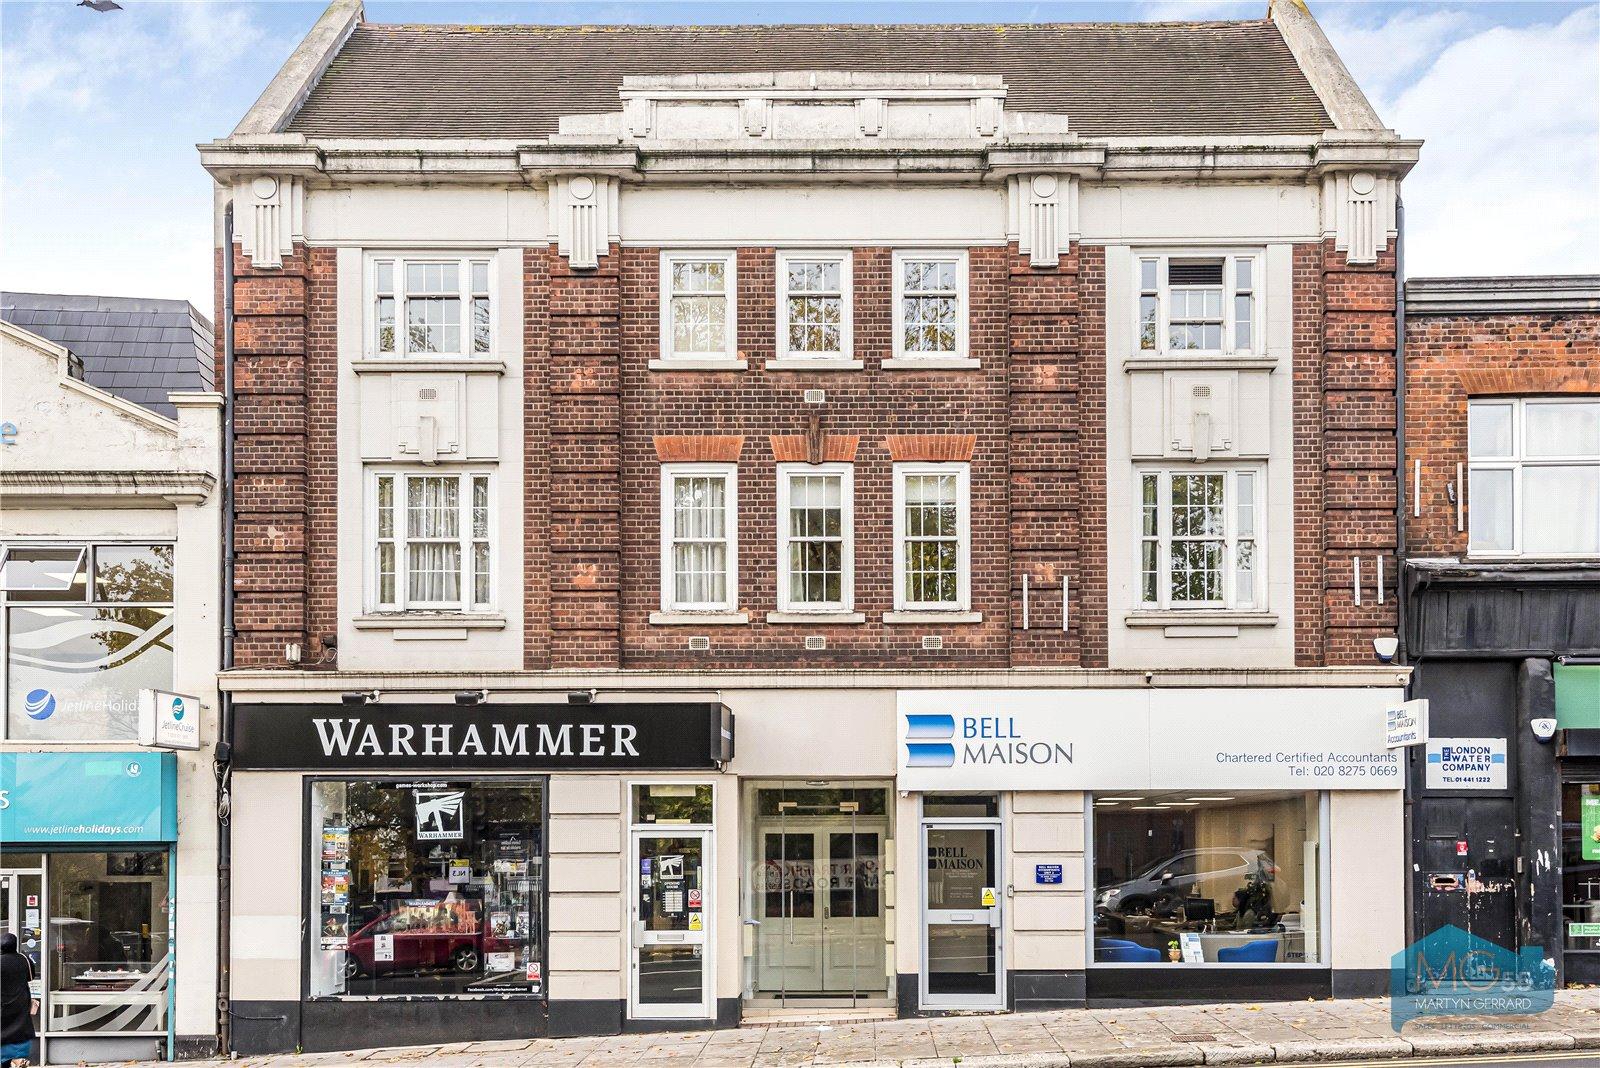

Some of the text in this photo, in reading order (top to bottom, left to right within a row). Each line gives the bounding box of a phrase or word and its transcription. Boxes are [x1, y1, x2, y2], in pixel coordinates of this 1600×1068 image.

[1396, 709, 1407, 719] BELL
[162, 720, 195, 733] JetlineCruise
[963, 717, 1022, 738] BELL
[1397, 718, 1417, 728] MAISON
[313, 719, 640, 757] WARHAMMER
[1387, 732, 1417, 743] Accountants
[963, 742, 1074, 764] MAISON
[1216, 752, 1398, 763] Chartered Certified Accountants
[1288, 765, 1398, 776] Tel: 020 8275 0669
[24, 824, 144, 836] www.jetlineholidays.com
[938, 847, 967, 858] BELL
[937, 859, 984, 869] MAISON
